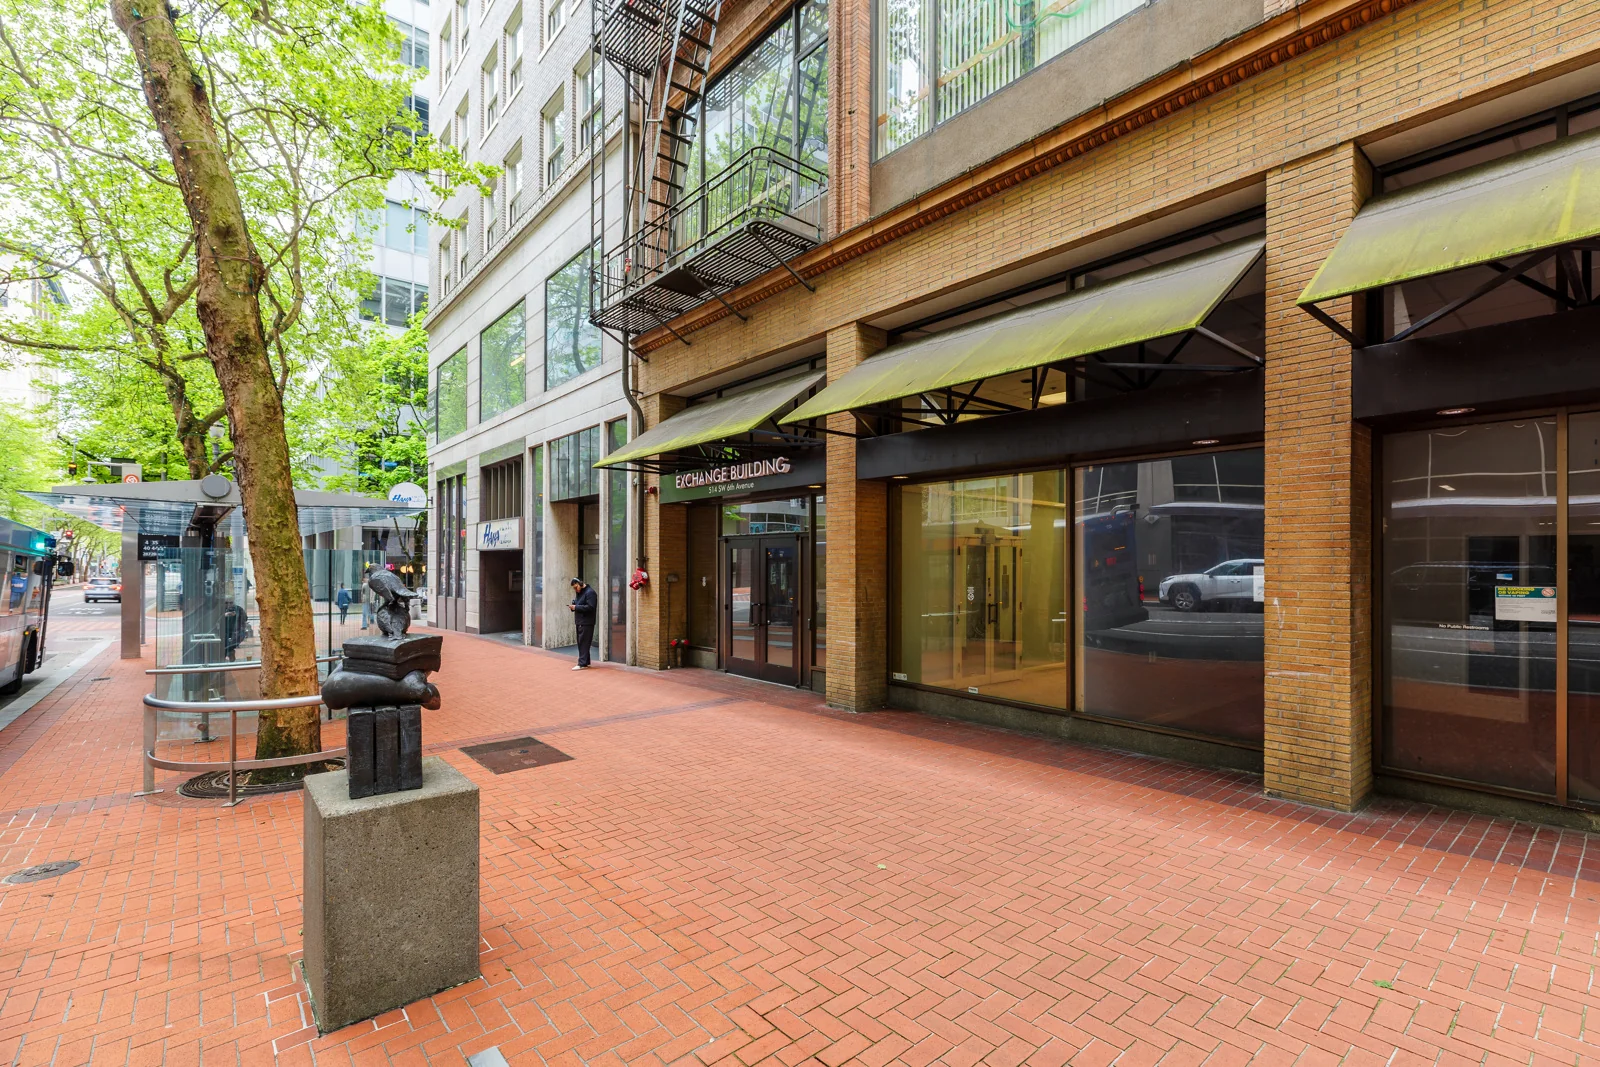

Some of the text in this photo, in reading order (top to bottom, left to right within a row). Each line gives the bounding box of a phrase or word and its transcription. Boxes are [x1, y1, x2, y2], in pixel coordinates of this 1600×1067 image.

[675, 456, 791, 489] EXCHANGE BUILDING
[708, 482, 755, 494] 514 SW 6th Avenue
